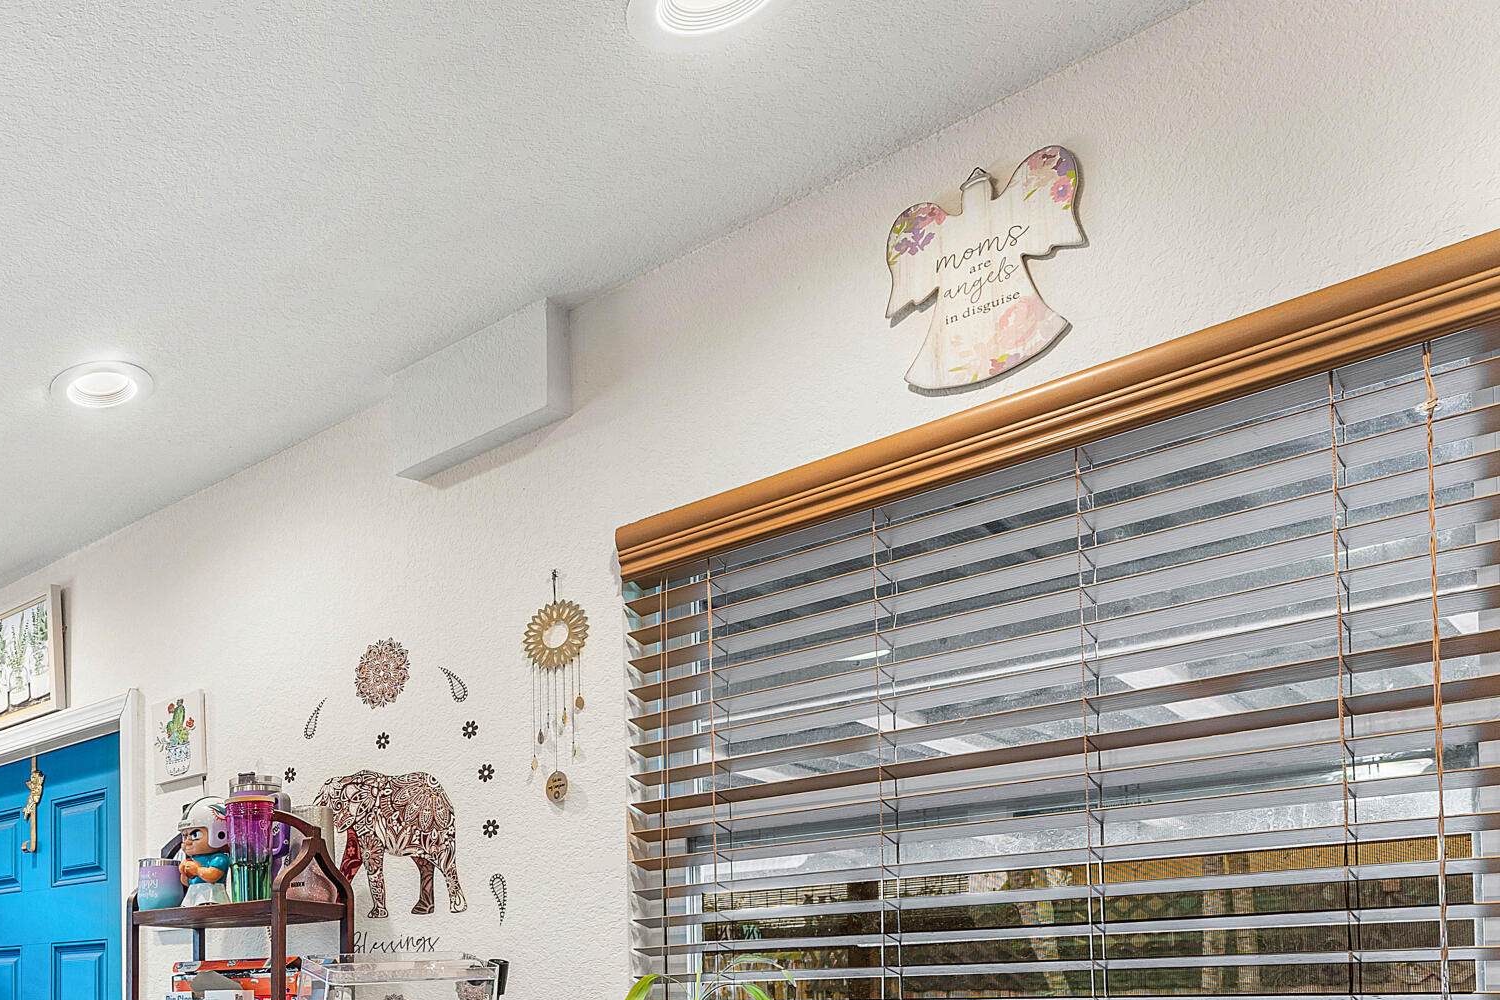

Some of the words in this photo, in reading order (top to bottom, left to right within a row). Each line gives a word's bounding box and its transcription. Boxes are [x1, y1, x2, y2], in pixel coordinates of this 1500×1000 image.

[936, 225, 1030, 273] moms
[969, 260, 991, 274] are
[943, 256, 1019, 304] angels
[945, 314, 958, 325] in
[962, 291, 1020, 319] disguise
